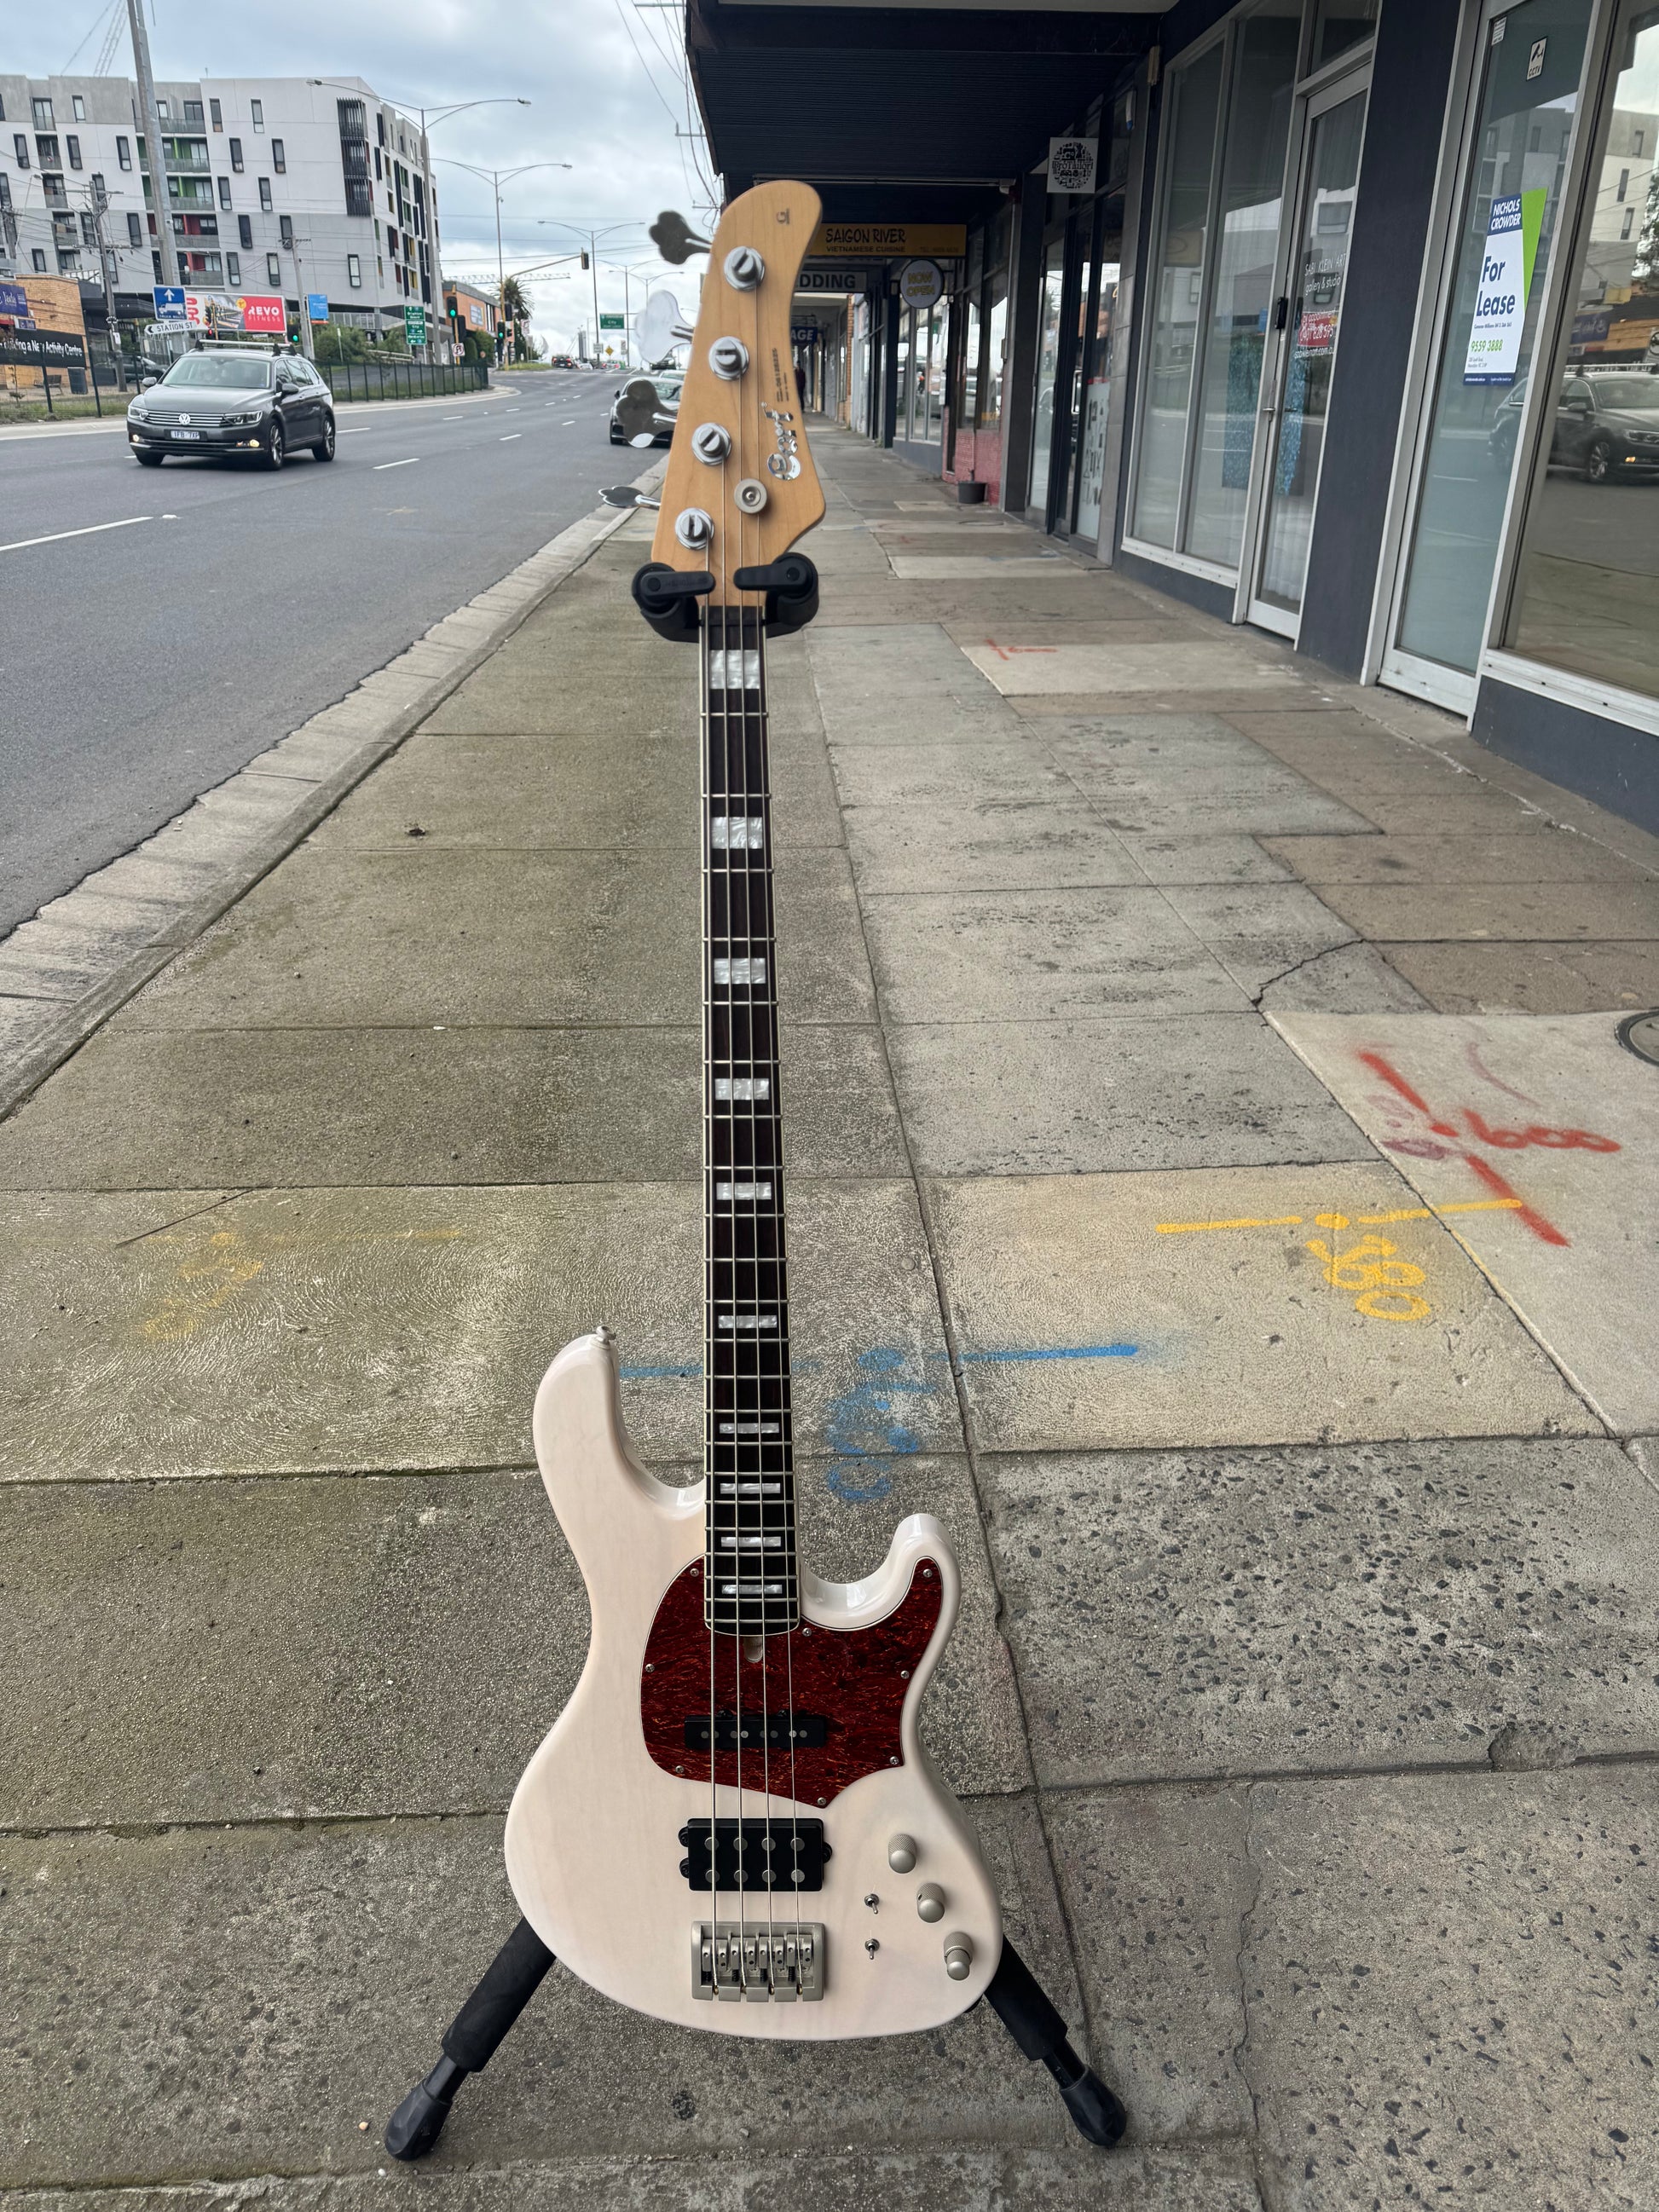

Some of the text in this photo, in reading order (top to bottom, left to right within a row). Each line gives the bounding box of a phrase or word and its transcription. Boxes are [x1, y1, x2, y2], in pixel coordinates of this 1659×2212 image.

[1493, 199, 1521, 217] NICHOLS
[1490, 213, 1522, 230] CROWDER
[826, 228, 906, 243] SAIGON RIVER
[1482, 256, 1506, 282] For
[907, 271, 934, 284] NOW
[1327, 275, 1341, 287] studio
[906, 285, 935, 297] OPEN
[1476, 291, 1515, 316] Lease
[248, 306, 280, 316] REVO
[156, 322, 183, 332] STATION
[1471, 340, 1486, 352] 9559
